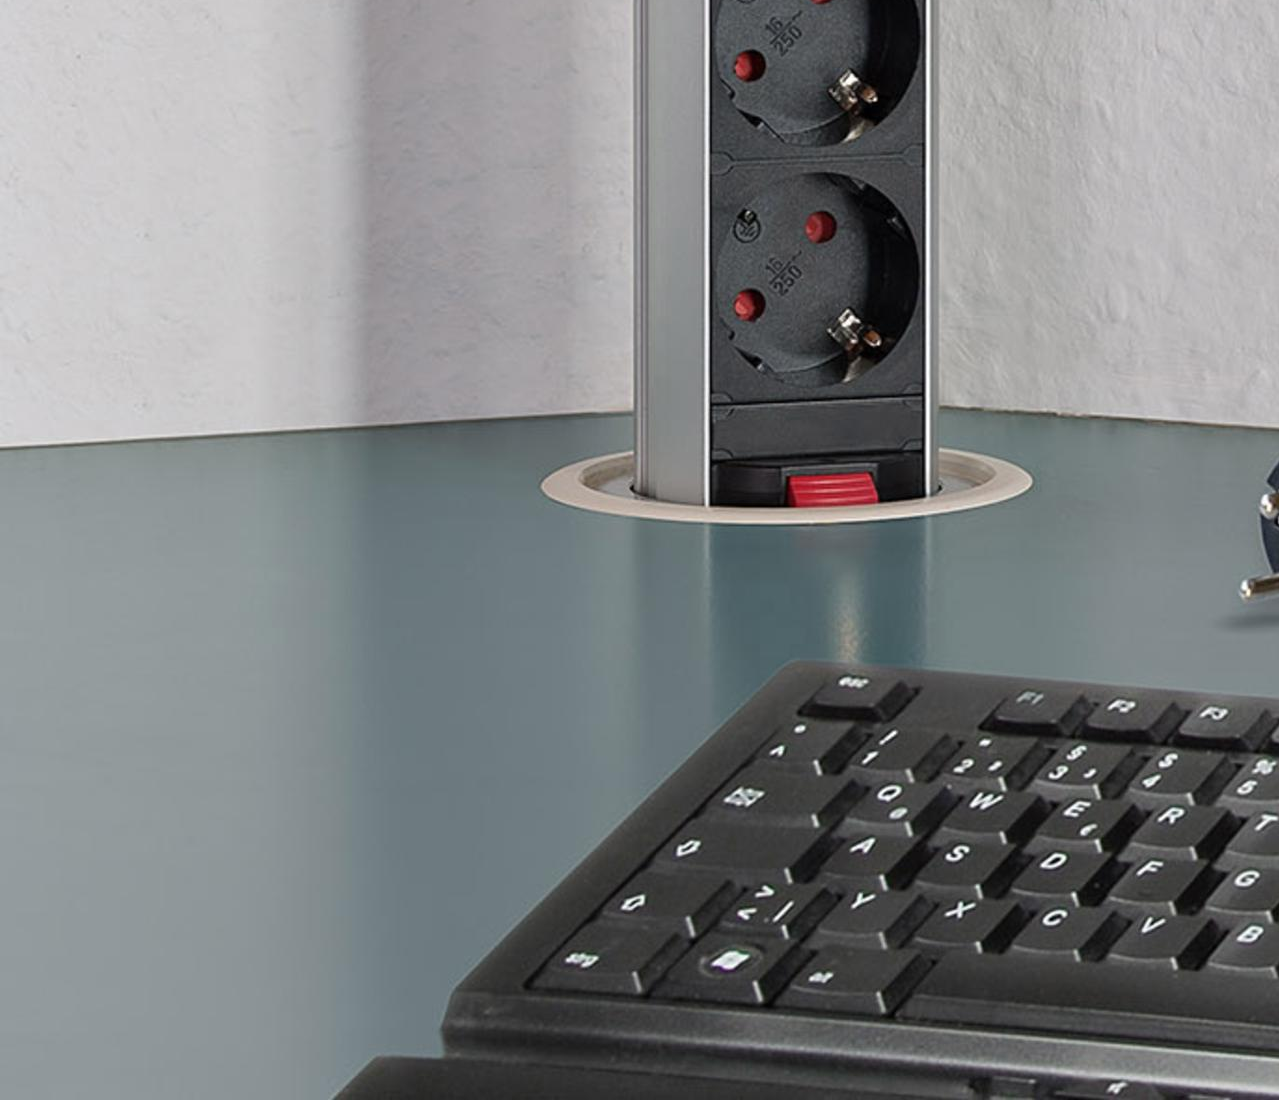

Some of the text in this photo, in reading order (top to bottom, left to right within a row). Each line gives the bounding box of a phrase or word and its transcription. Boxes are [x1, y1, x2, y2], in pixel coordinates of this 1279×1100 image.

[1016, 691, 1044, 705] F1
[953, 758, 974, 774] 2
[1048, 765, 1069, 780] 3
[877, 784, 902, 802] Q
[1236, 780, 1258, 795] 5
[968, 792, 1005, 810] W
[1063, 800, 1092, 818] E
[1157, 807, 1185, 824] R
[1254, 814, 1279, 831] T
[849, 837, 876, 854] A
[945, 845, 970, 862] S
[1039, 852, 1067, 870] D
[1136, 860, 1164, 876] F
[1234, 870, 1260, 887] G
[851, 892, 876, 909] Y
[944, 901, 976, 919] X
[1042, 909, 1068, 926] C
[1141, 916, 1166, 934] V
[1236, 925, 1264, 943] B
